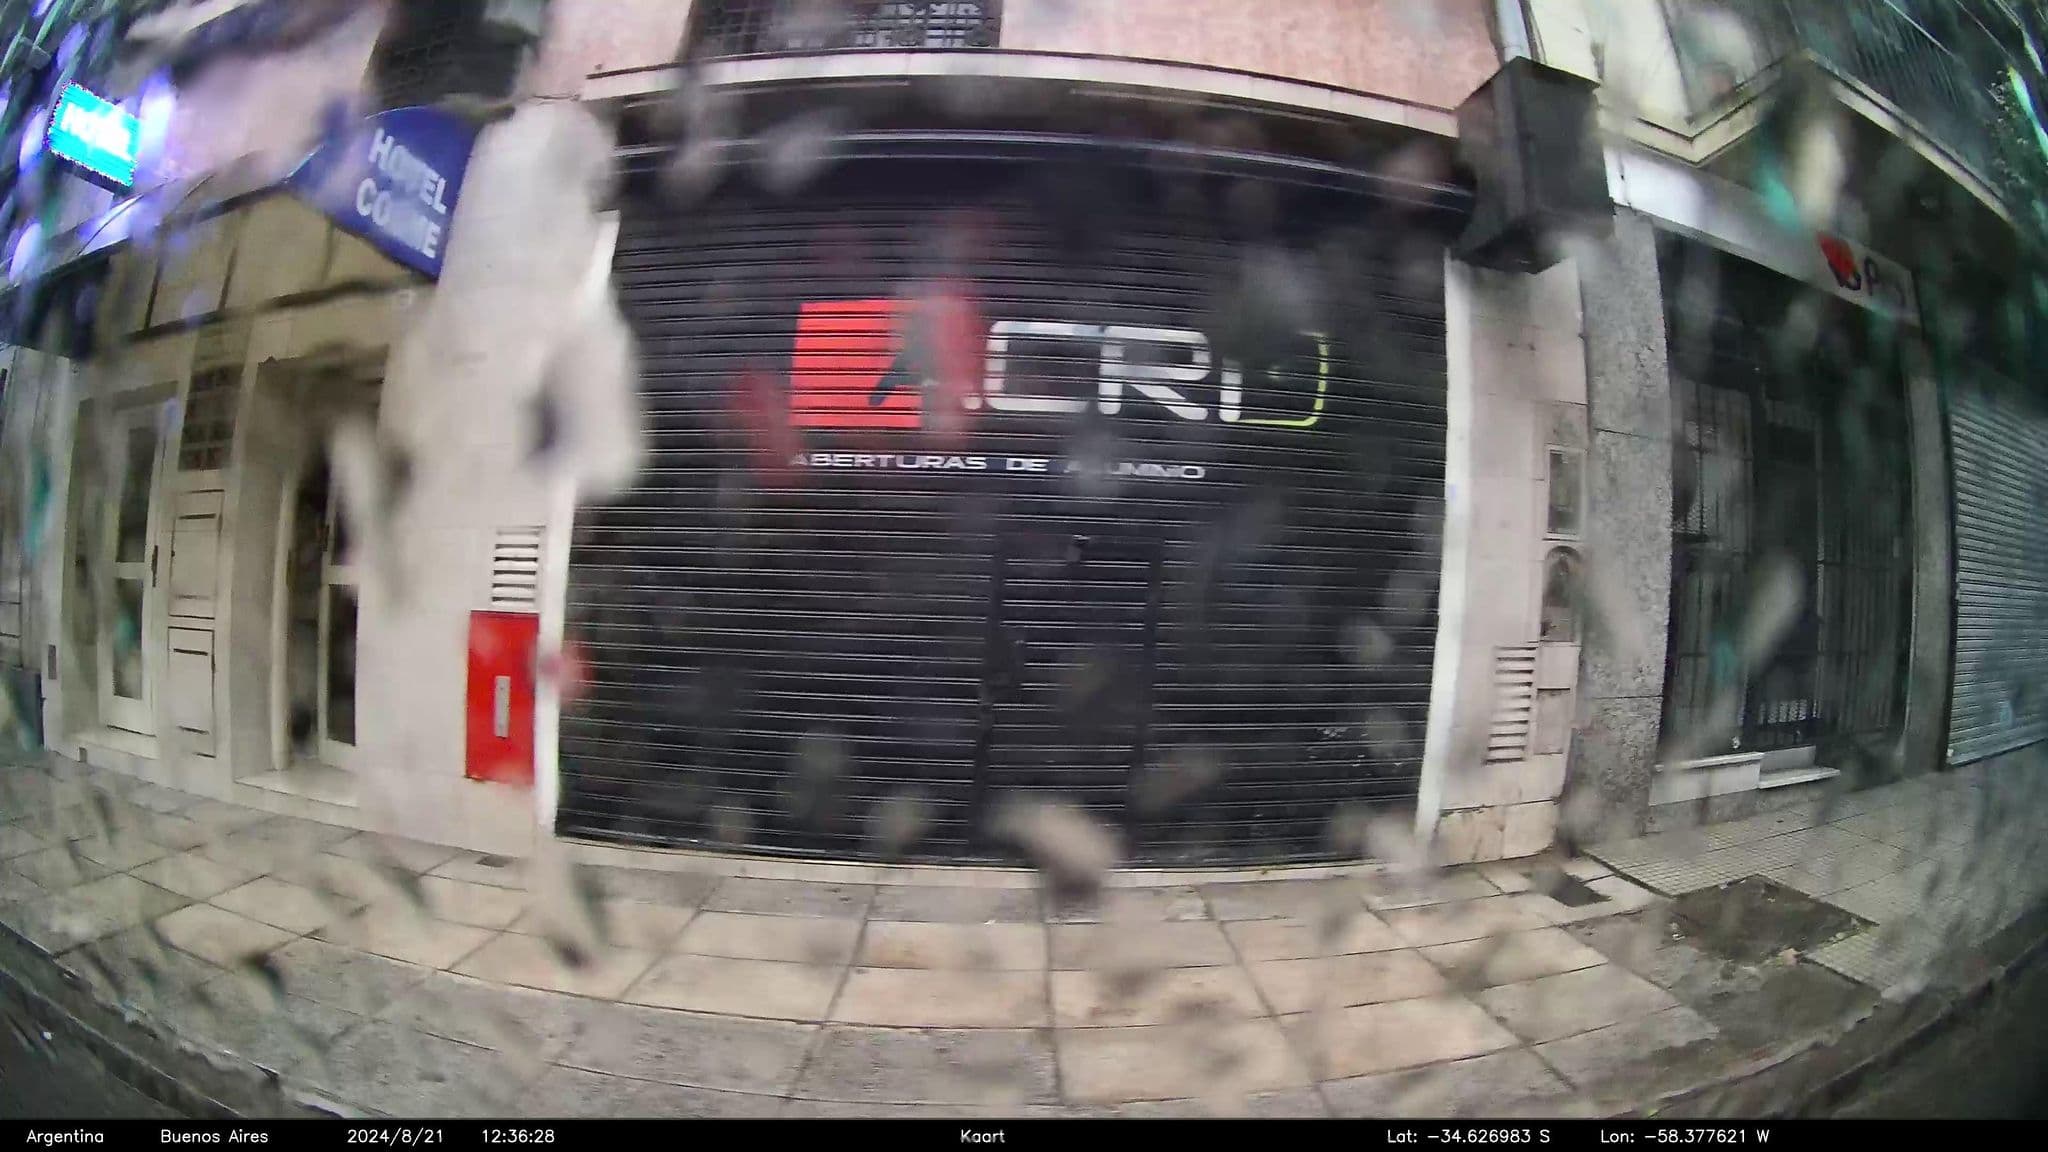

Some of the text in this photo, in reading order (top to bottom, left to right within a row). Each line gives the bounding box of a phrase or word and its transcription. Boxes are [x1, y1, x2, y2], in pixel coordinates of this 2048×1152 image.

[367, 128, 447, 215] HOEL
[356, 177, 441, 259] COE
[791, 453, 988, 470] ABERTURAS
[1006, 457, 1049, 472] DE
